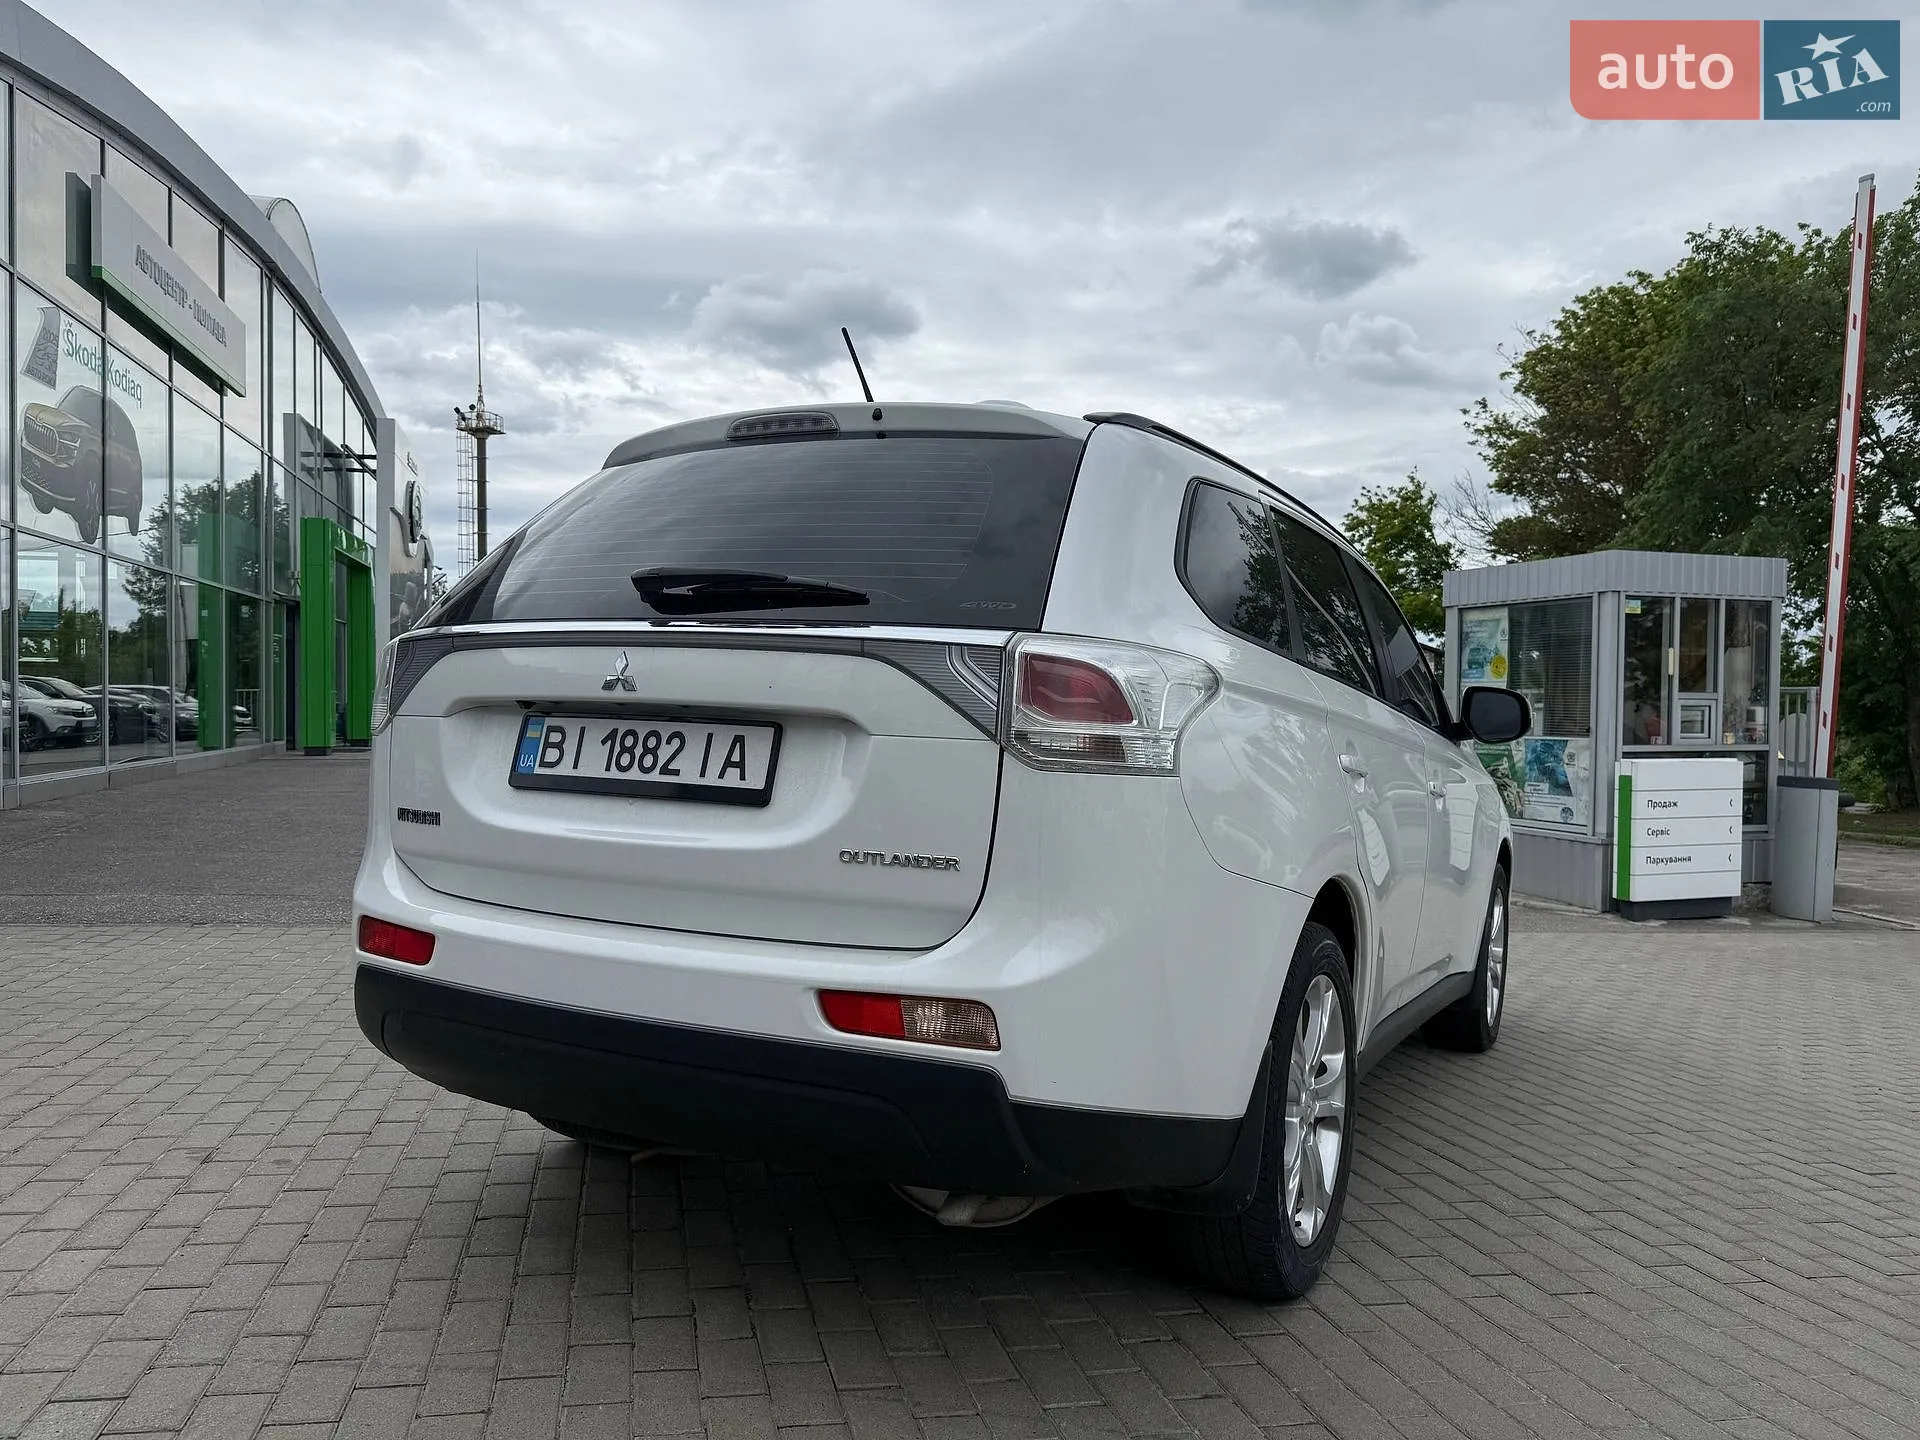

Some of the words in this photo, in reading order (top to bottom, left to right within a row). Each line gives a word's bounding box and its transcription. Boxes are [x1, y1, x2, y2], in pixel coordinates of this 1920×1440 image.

[135, 244, 188, 309] АВТОЦЕНТР
[107, 355, 142, 408] Kodiaq
[520, 754, 534, 769] UA
[539, 726, 586, 769] BI
[600, 727, 687, 777] 1882
[699, 733, 747, 781] IA
[1647, 799, 1678, 810] Продаж
[1646, 827, 1670, 838] Сервіс
[839, 848, 961, 872] OUTLANDER
[1645, 855, 1692, 866] Паркування
